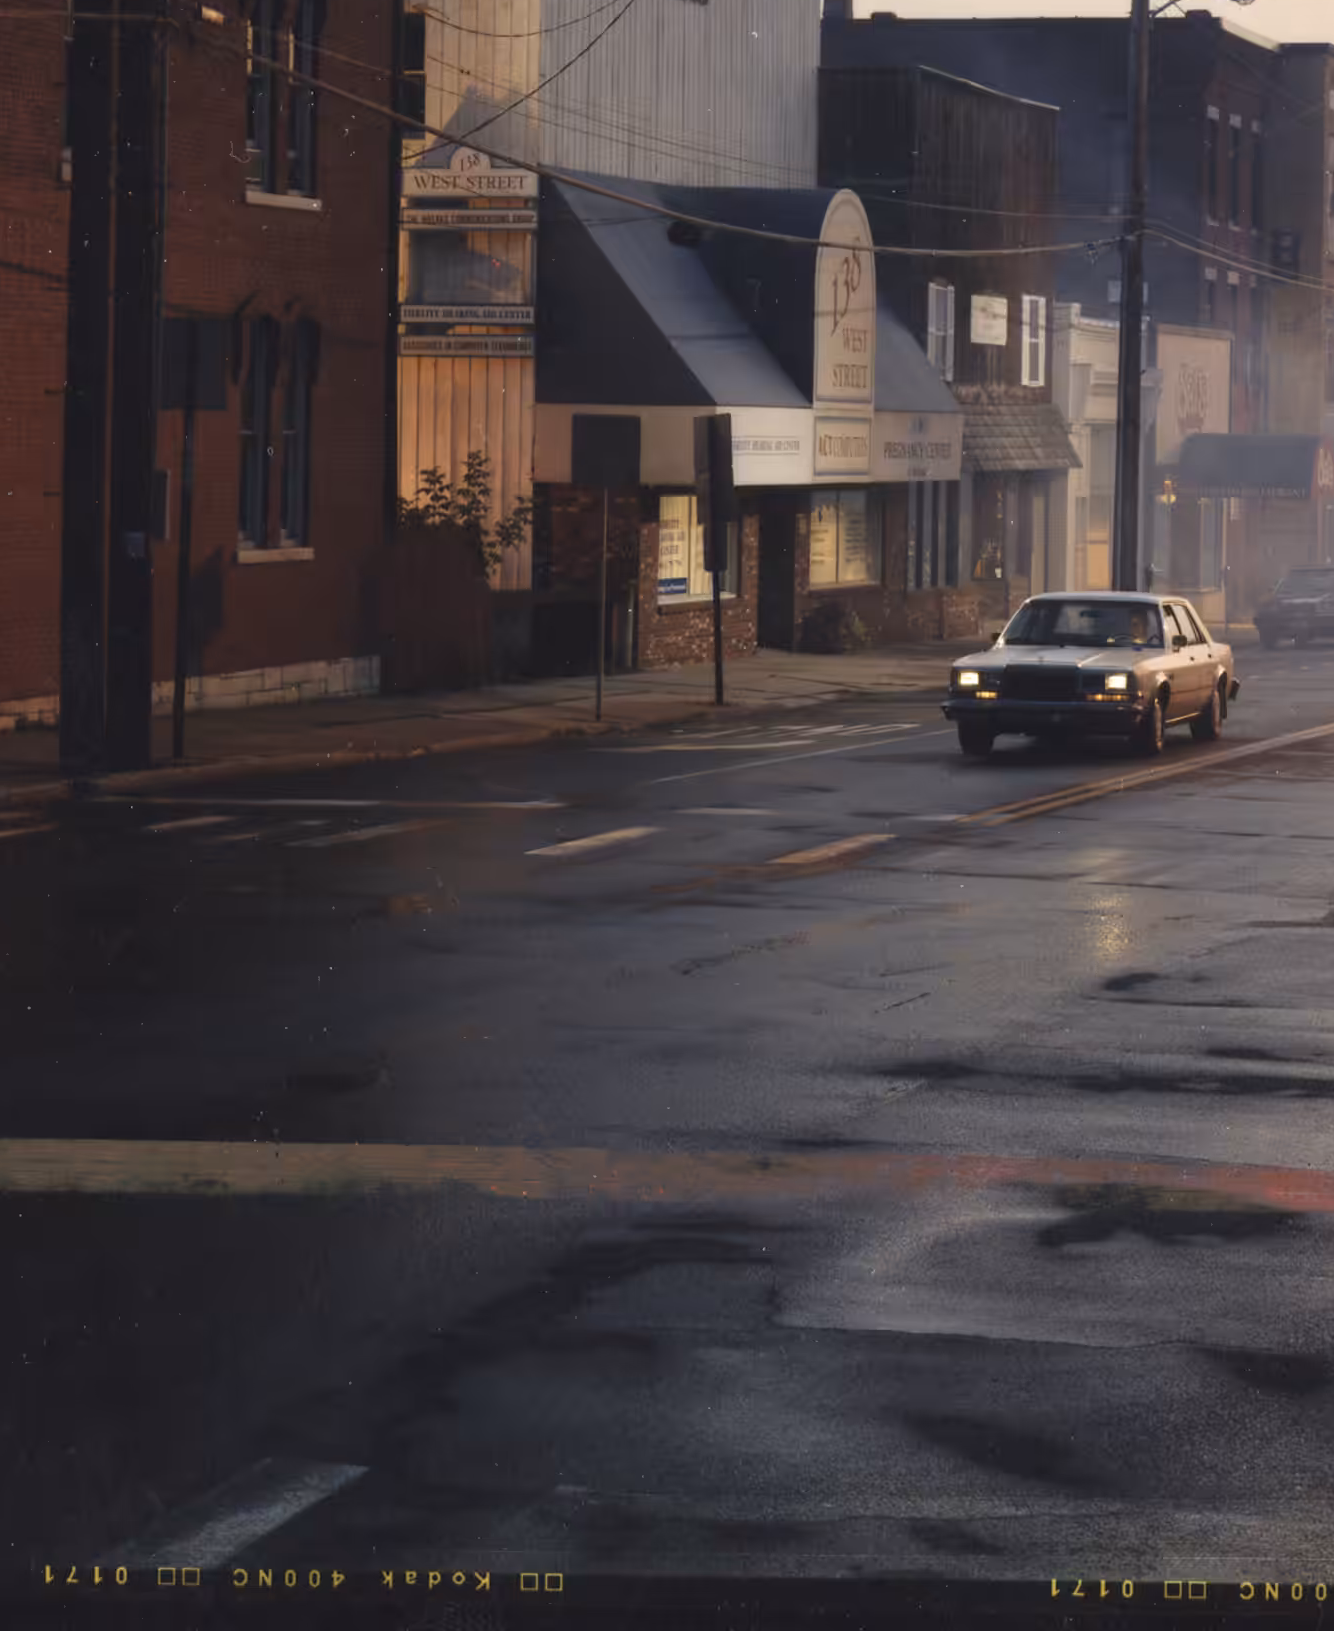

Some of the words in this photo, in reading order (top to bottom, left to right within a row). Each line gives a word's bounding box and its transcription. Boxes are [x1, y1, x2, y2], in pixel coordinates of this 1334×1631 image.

[413, 176, 459, 189] WEST
[466, 176, 527, 190] STREET
[830, 236, 862, 337] 138
[842, 327, 867, 353] WEST
[832, 363, 868, 389] STREET
[46, 1565, 127, 1584] 0171
[235, 1568, 345, 1587] 400NC
[383, 1571, 489, 1590] Kodak
[1052, 1578, 1133, 1597] 0171
